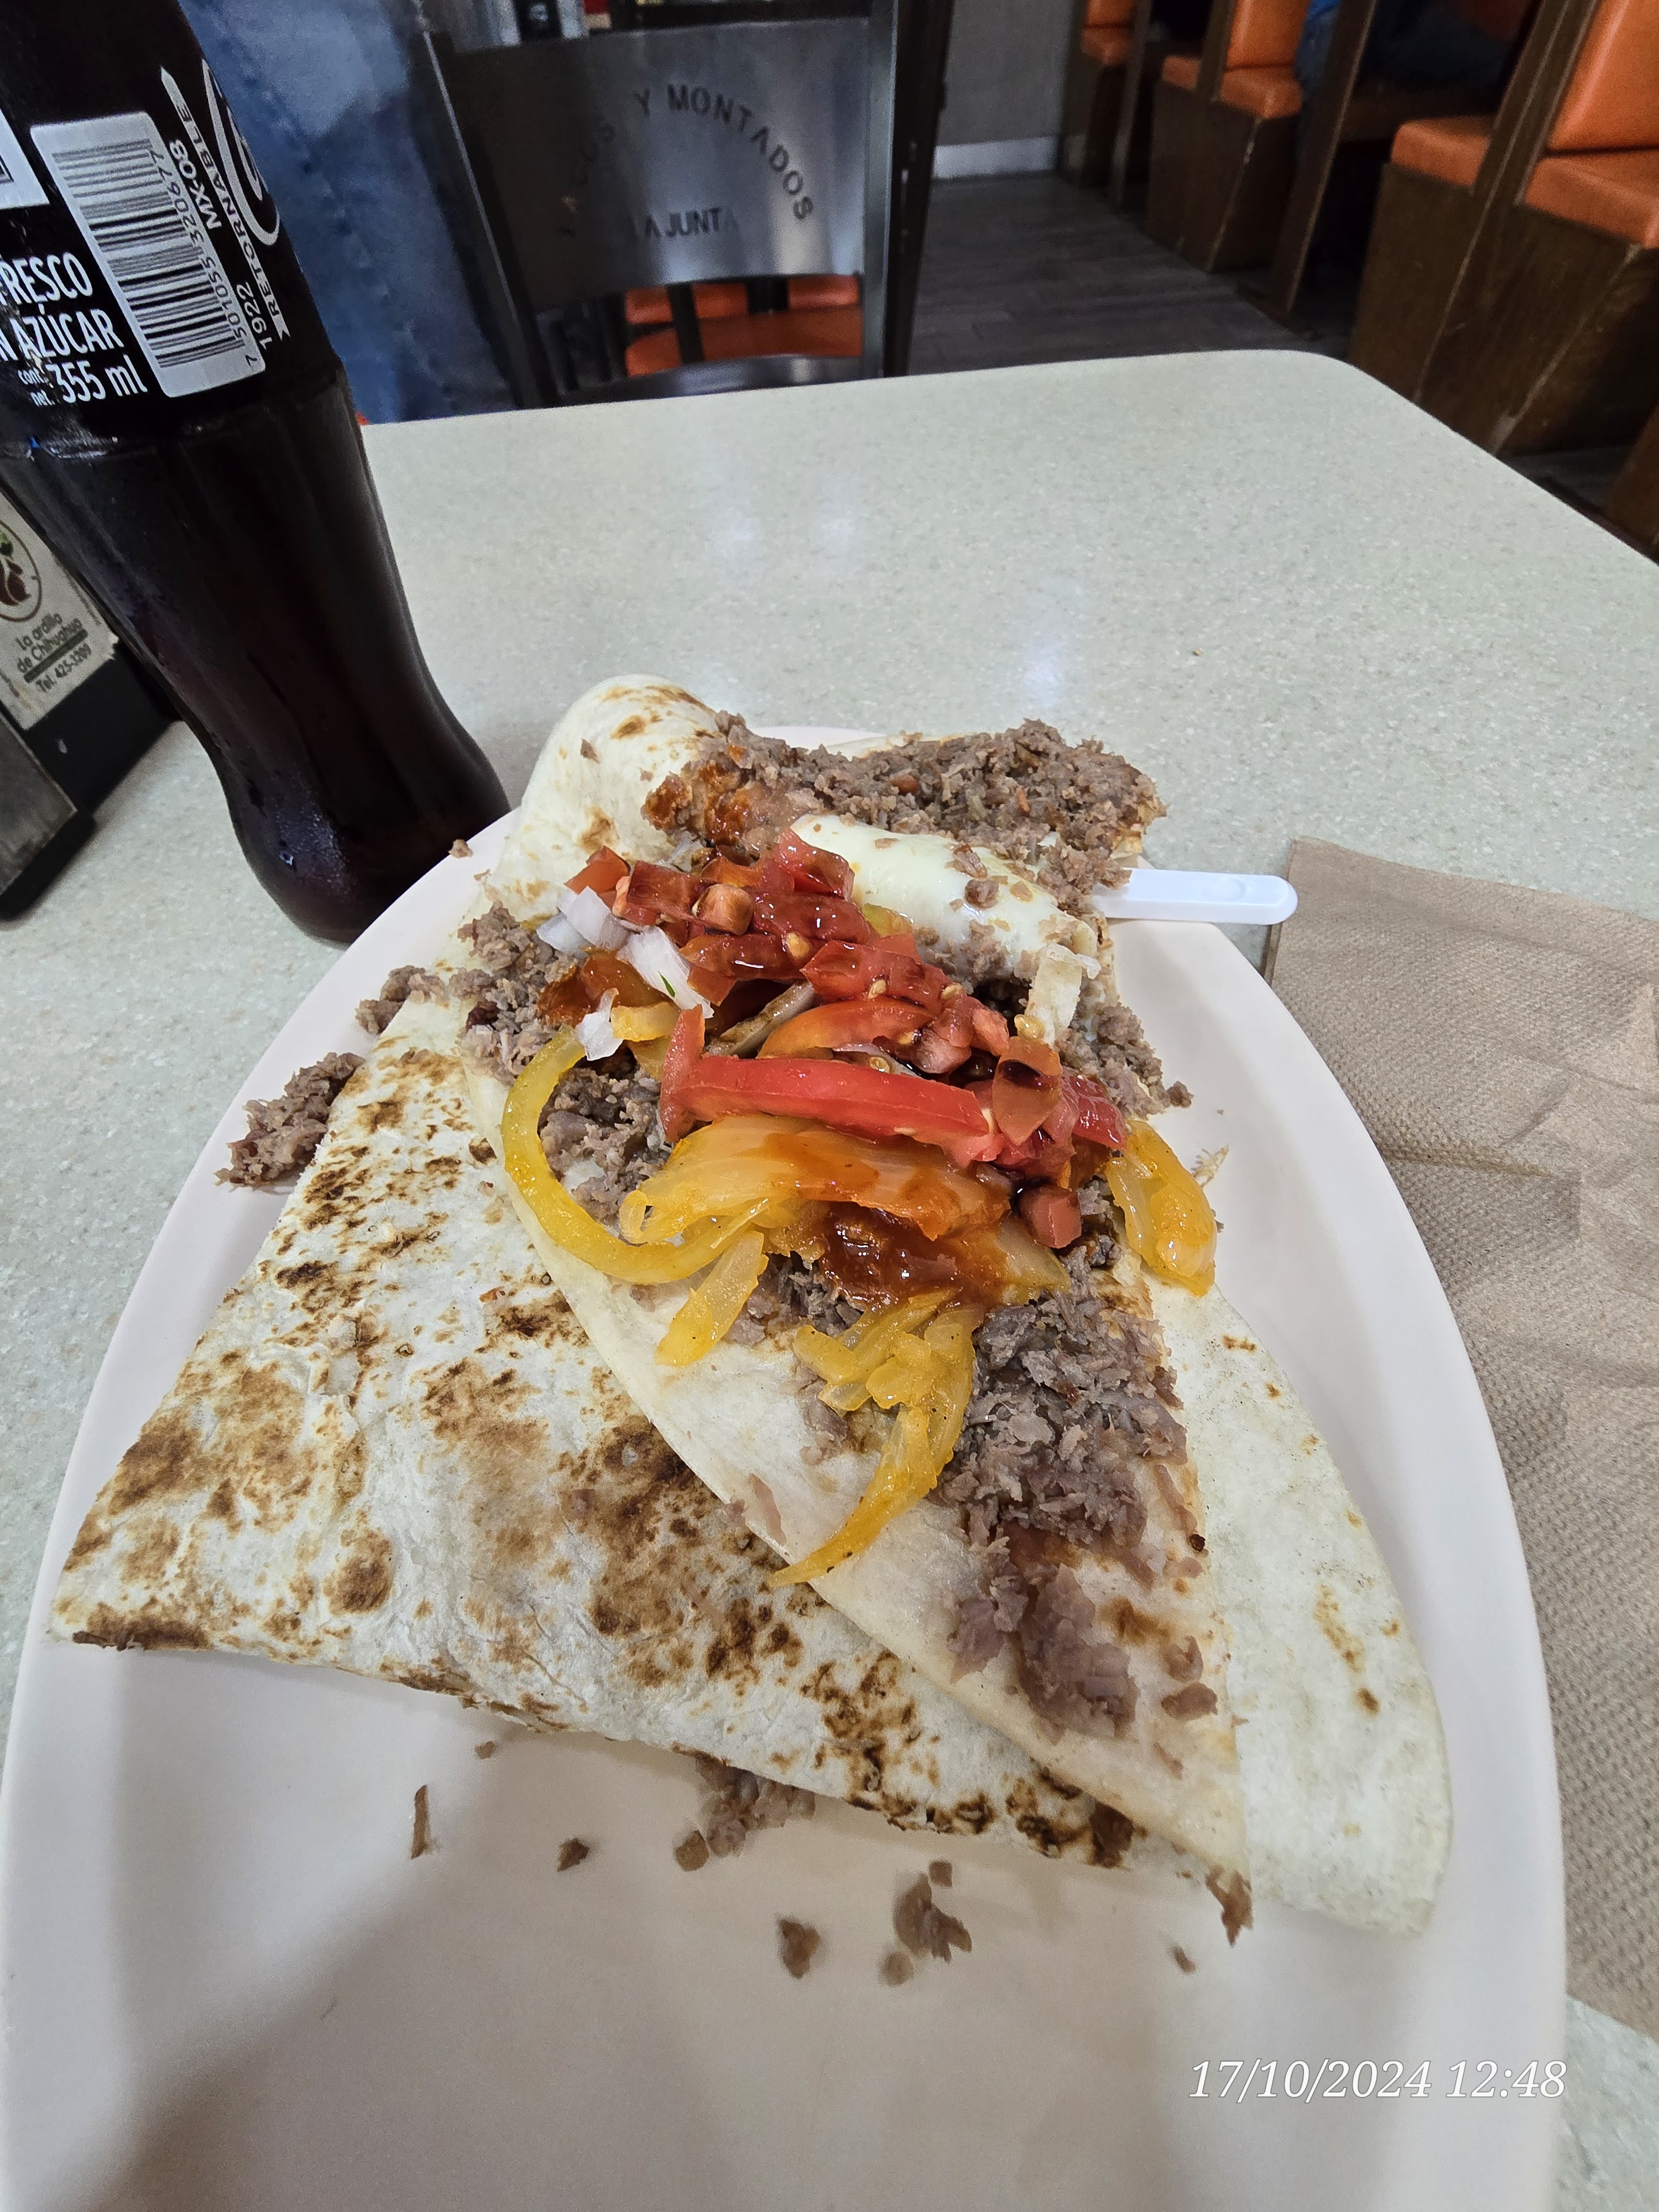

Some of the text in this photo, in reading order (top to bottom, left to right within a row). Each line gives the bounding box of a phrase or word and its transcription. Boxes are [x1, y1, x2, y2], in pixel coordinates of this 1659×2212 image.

[169, 139, 222, 229] MX-08
[633, 87, 650, 118] Y
[667, 84, 814, 221] MONTADOS
[149, 149, 205, 245] 320677
[176, 104, 279, 317] RETORNABLE
[10, 303, 124, 361] AZÚCAR
[201, 256, 247, 341] 501055
[237, 281, 272, 350] 1922
[45, 359, 106, 404] 355
[105, 353, 148, 397] ml
[245, 354, 258, 367] 7
